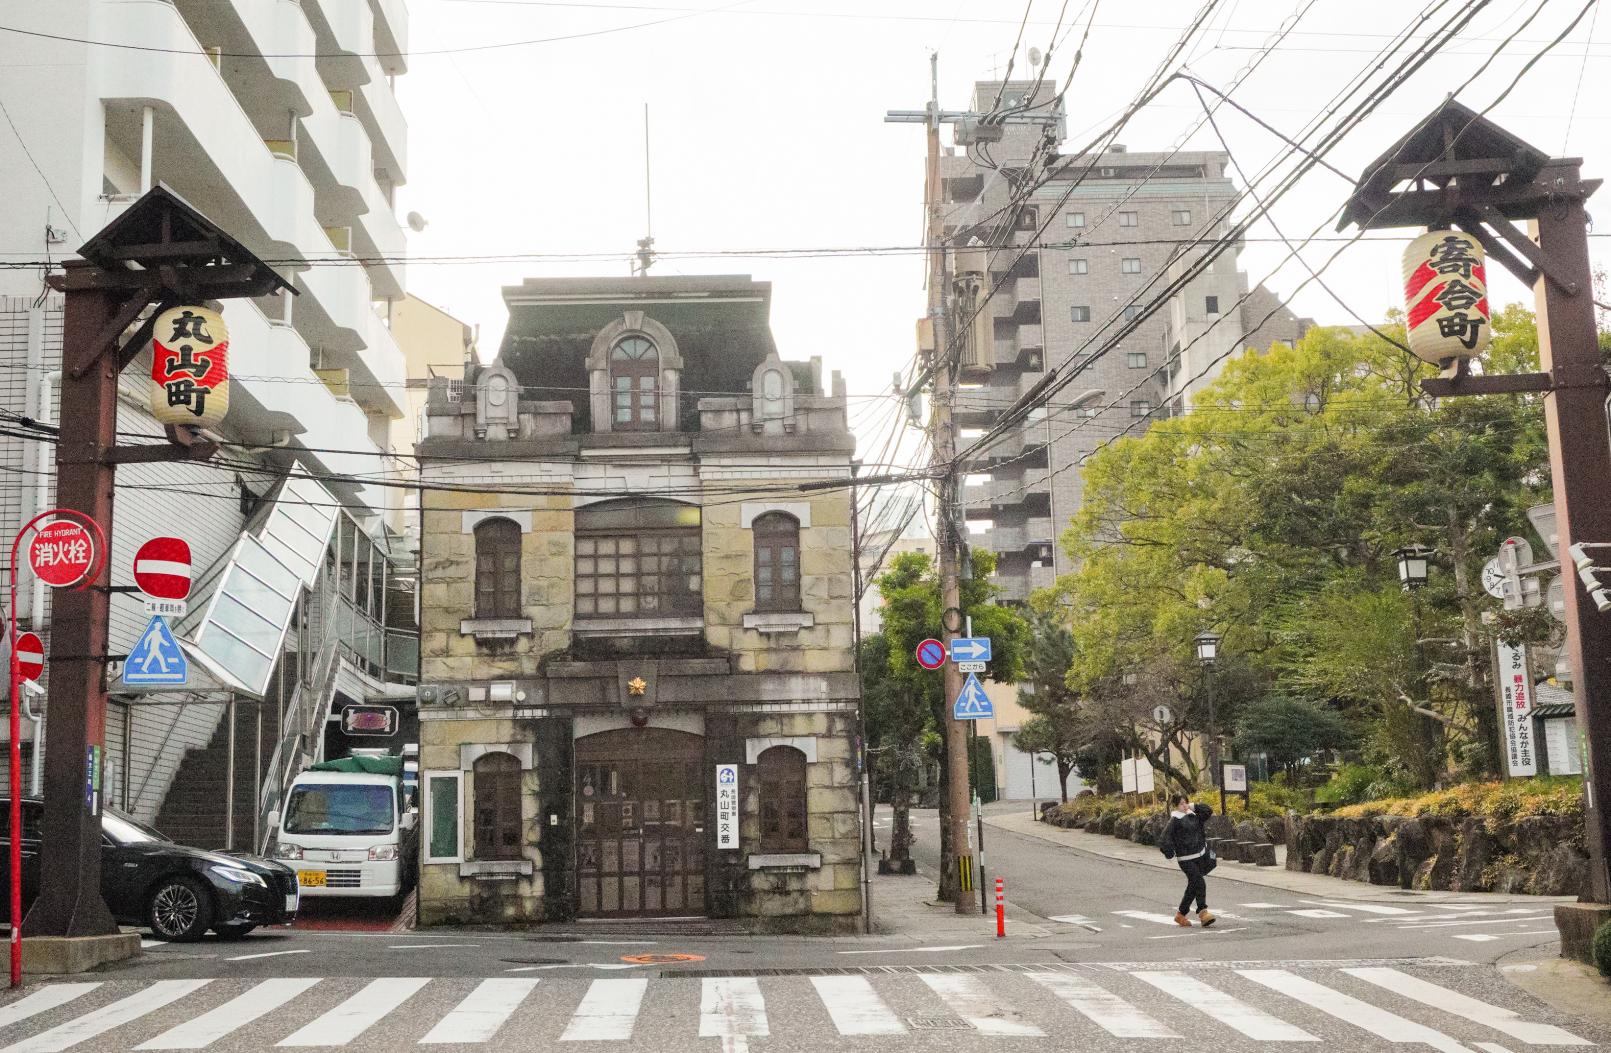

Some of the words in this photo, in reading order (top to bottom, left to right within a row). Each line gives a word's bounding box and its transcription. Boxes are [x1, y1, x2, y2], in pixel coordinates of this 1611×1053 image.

[1428, 235, 1486, 350] 寄合町
[164, 310, 214, 417] 丸山町
[34, 539, 88, 567] 消火栓
[39, 530, 52, 539] FIRE
[54, 528, 81, 537] HYDRANT
[1514, 674, 1526, 709] 暴力追放
[1517, 714, 1531, 766] みんなが主役
[720, 789, 730, 844] 丸山町交番
